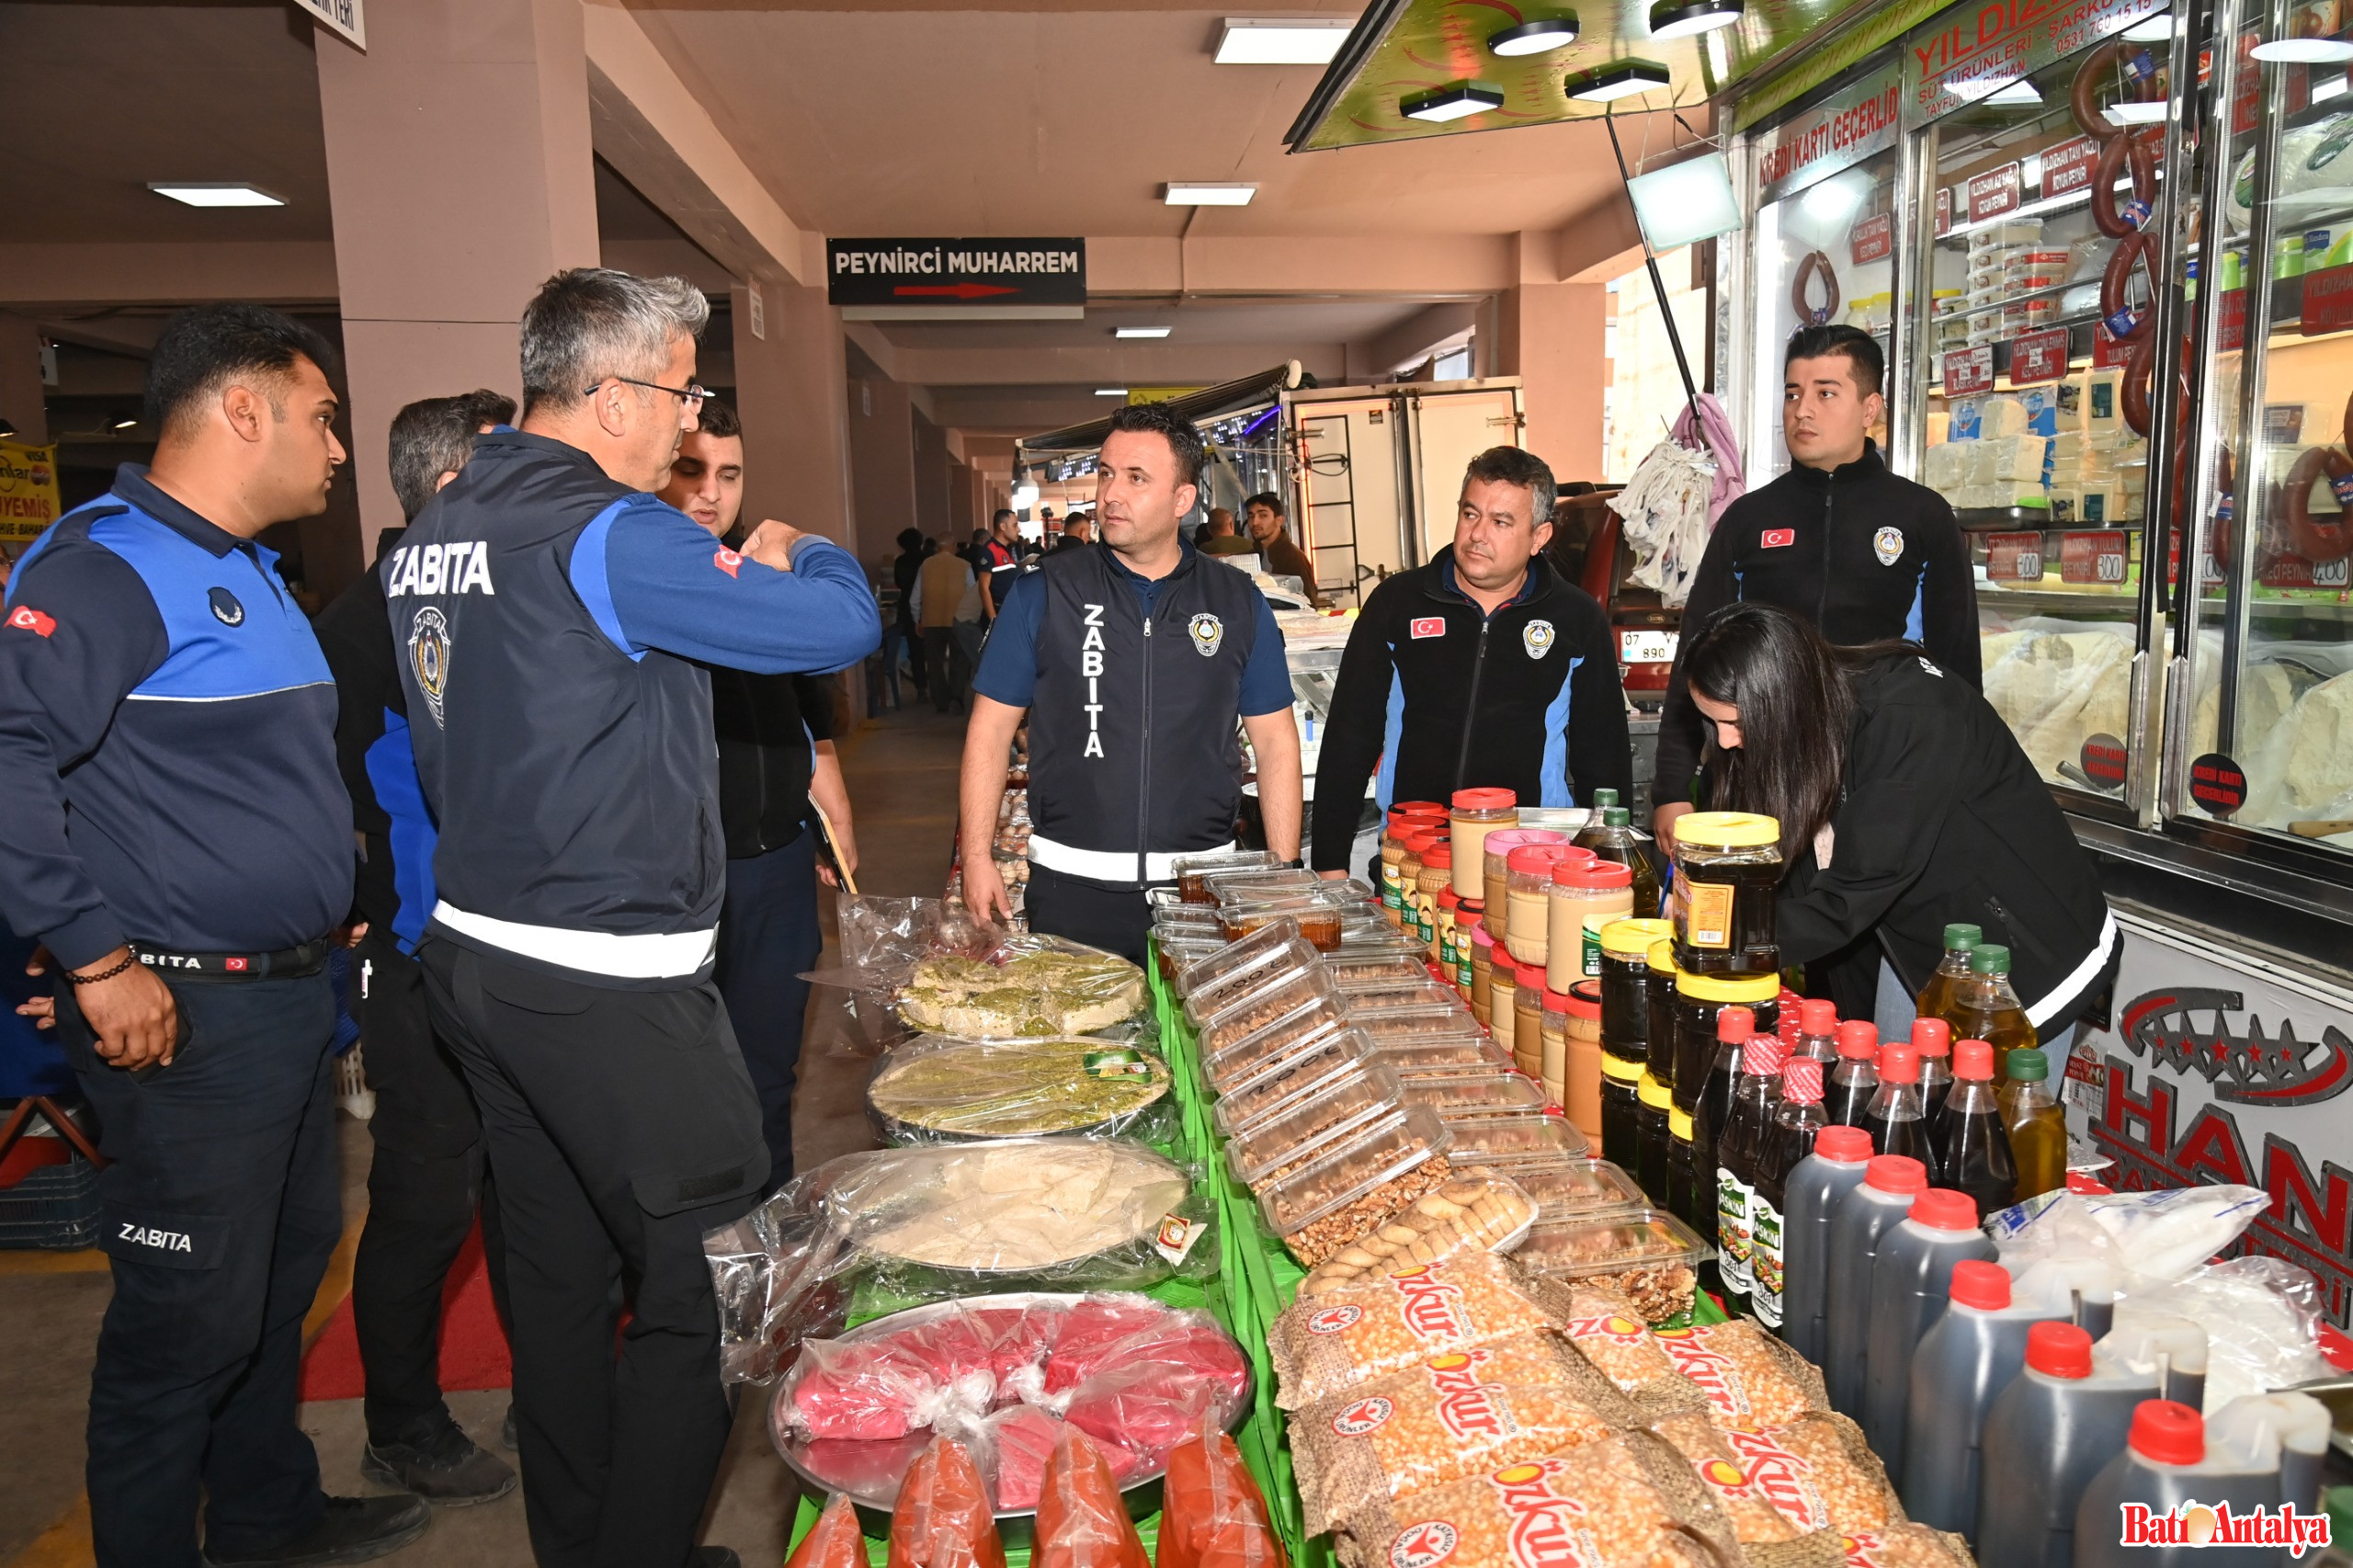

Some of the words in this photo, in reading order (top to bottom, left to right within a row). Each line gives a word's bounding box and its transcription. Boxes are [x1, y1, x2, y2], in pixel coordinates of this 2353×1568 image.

[1914, 0, 2079, 76] YILDIZ
[2056, 30, 2085, 54] 0531
[2089, 14, 2111, 38] 760
[2117, 5, 2131, 26] 15
[1918, 79, 1945, 104] SÜT
[1951, 31, 2032, 88] ÜRÜNLERİ
[1965, 59, 2026, 101] YILDIZHAN
[1759, 134, 1790, 187] KREDİ
[1794, 122, 1829, 170] KARTI
[1833, 83, 1898, 152] GEÇERLİD
[835, 246, 942, 274] PEYNİRCİ
[948, 251, 1078, 273] MUHARREM
[389, 541, 495, 597] ZABITA
[2313, 559, 2347, 585] 400
[1625, 634, 1640, 645] 07
[1643, 648, 1665, 658] 890
[1082, 604, 1106, 758] ZABITA
[141, 954, 201, 970] BITA
[2105, 1061, 2351, 1258] HAN
[118, 1223, 192, 1253] ZABITA
[1427, 1350, 1509, 1440] Özkur
